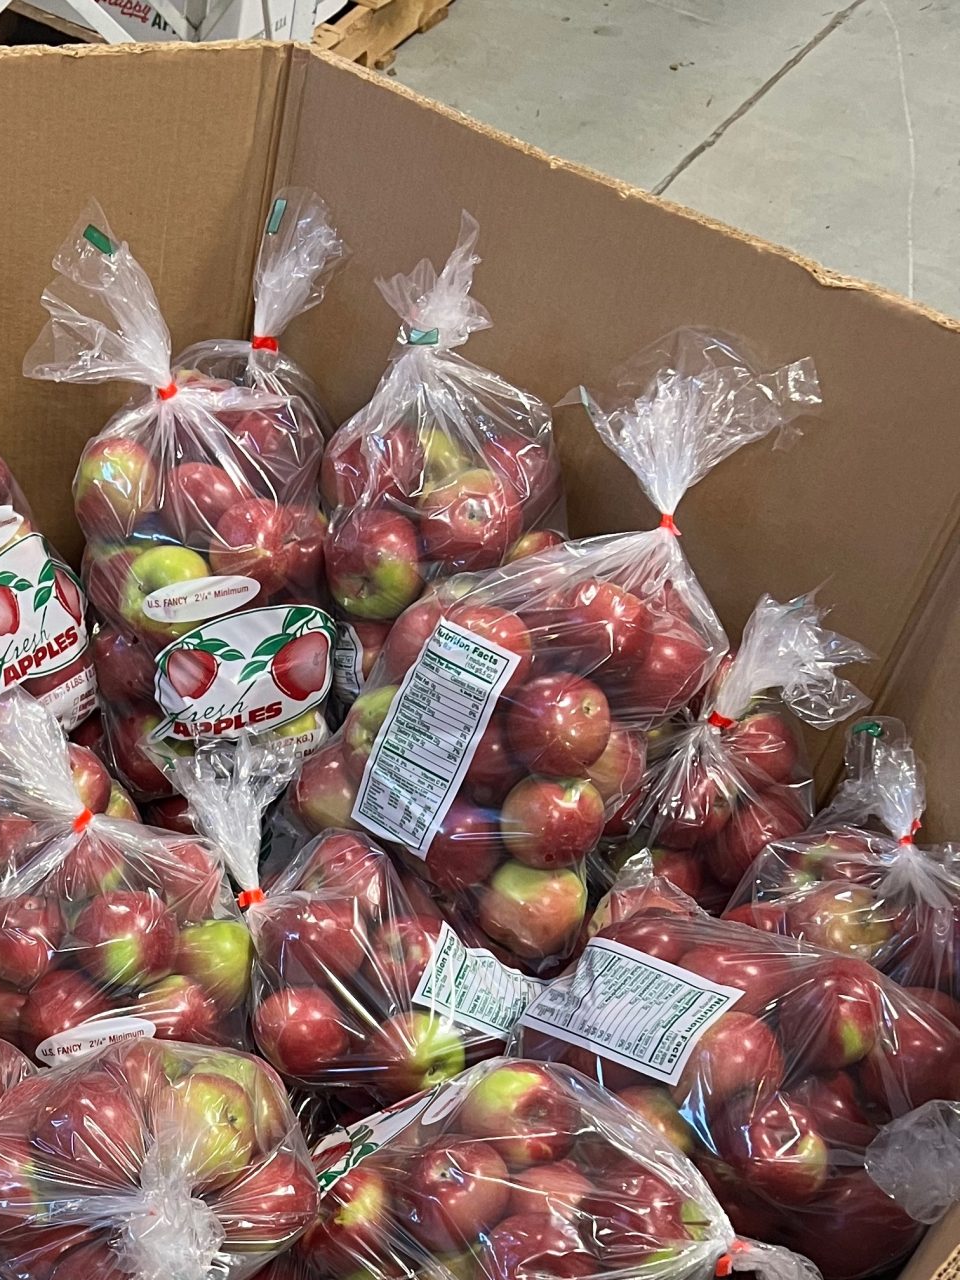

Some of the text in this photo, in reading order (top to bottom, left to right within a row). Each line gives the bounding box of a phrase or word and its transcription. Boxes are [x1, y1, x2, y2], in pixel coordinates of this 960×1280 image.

[147, 598, 161, 608] U.S.
[163, 596, 187, 607] FANCY
[214, 585, 249, 598] Minimum
[3, 626, 78, 687] APPLES
[471, 646, 499, 665] Facts
[173, 701, 282, 737] APPLES
[296, 733, 314, 746] KG.)
[41, 1049, 55, 1057] U.S.
[57, 1043, 82, 1056] FANCY
[109, 1029, 144, 1043] Minimum
[666, 997, 723, 1065] Nutrition Facts
